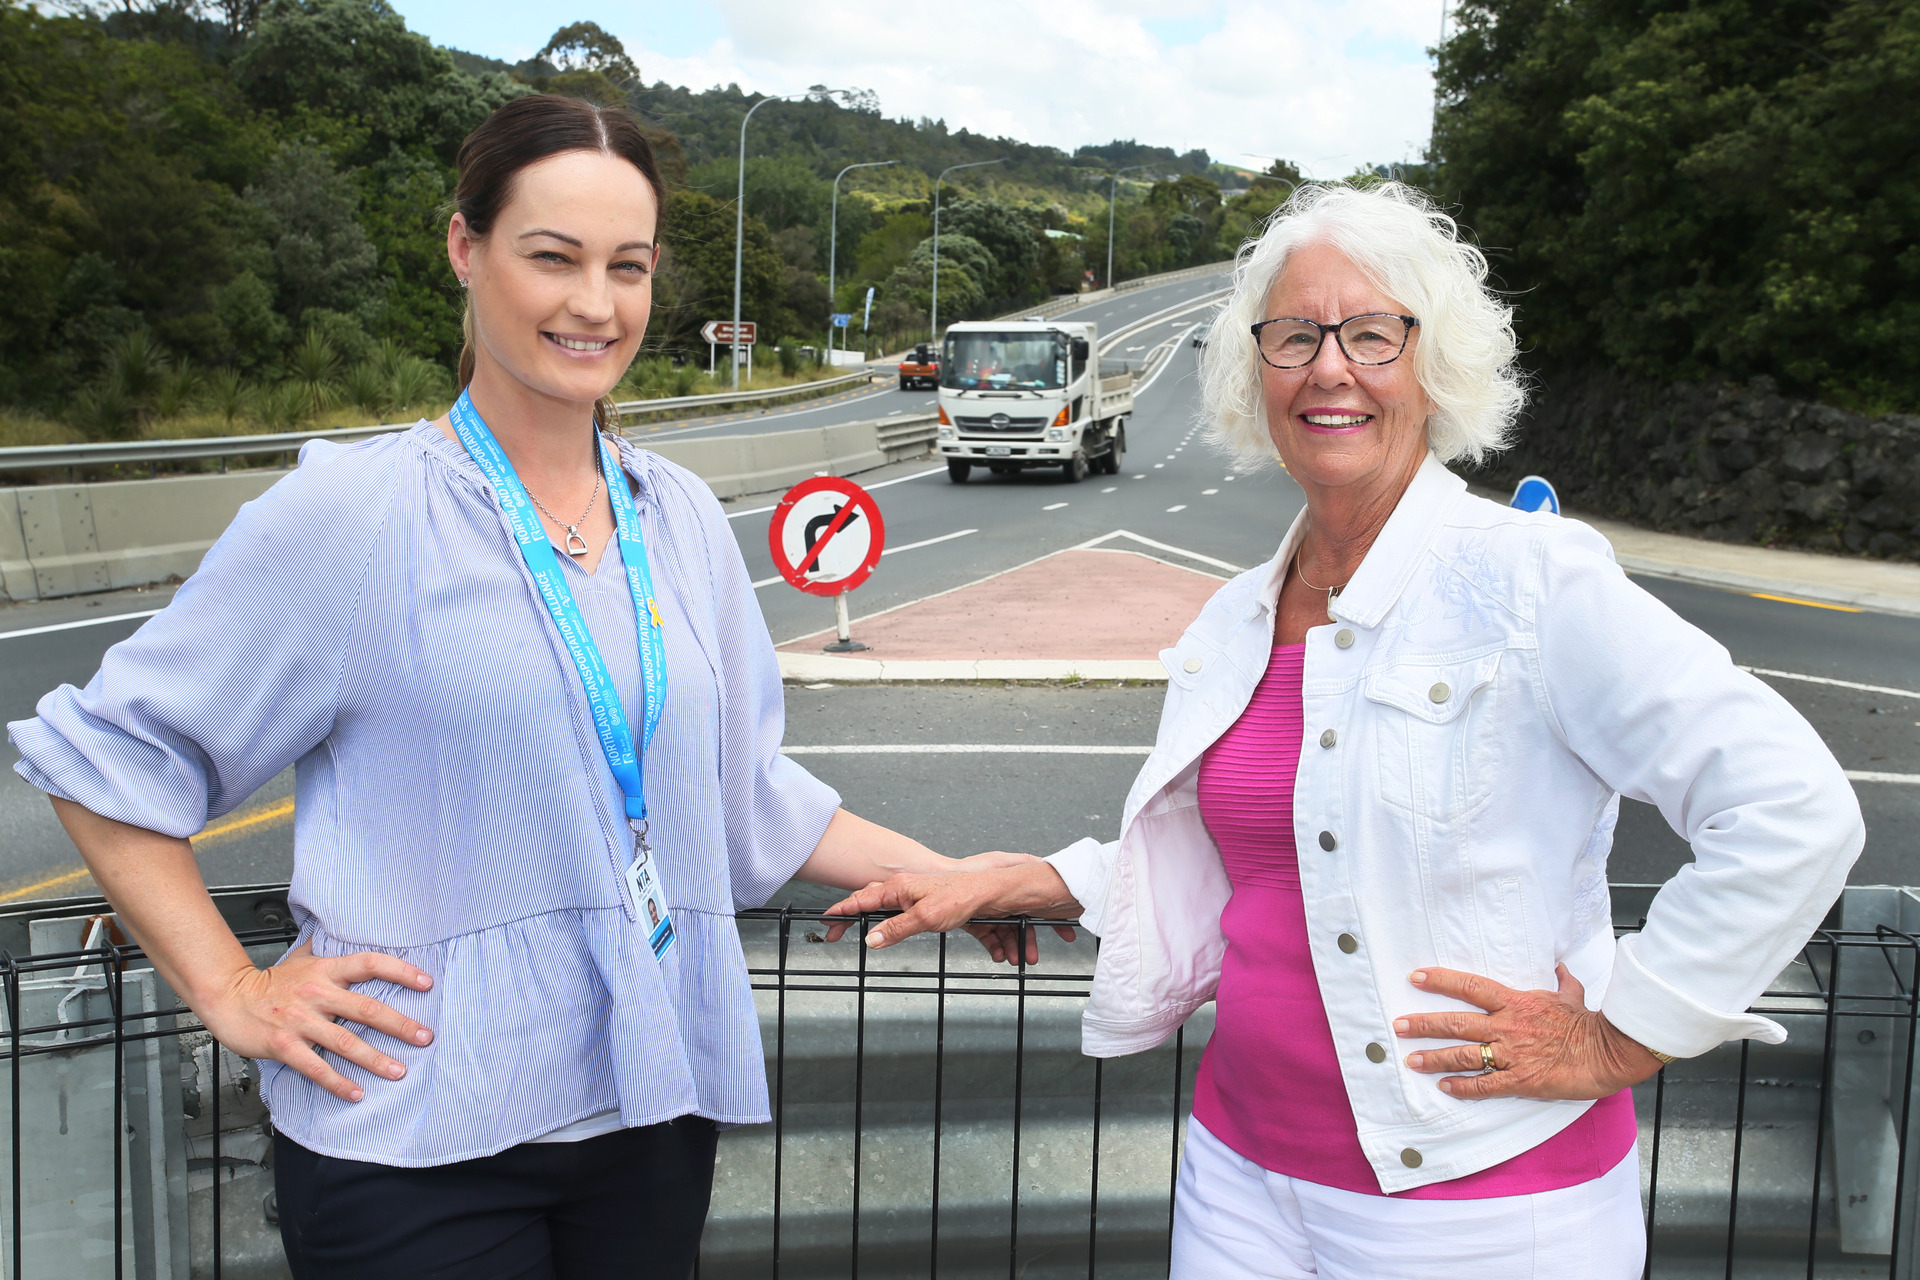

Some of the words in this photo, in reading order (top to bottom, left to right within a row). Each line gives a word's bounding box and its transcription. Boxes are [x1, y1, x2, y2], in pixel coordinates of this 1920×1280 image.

[456, 421, 504, 488] TRANSPORTATION
[498, 488, 532, 545] NORTHLAND
[611, 488, 630, 541] NORTHLAND
[535, 570, 565, 616] ALLIANCE
[628, 564, 646, 609] ALLIANCE
[557, 617, 602, 705] TRANSPORTATION
[638, 609, 656, 693] TRANSPORTATION
[594, 705, 621, 766] NORTHLAND
[636, 868, 651, 893] NTA
